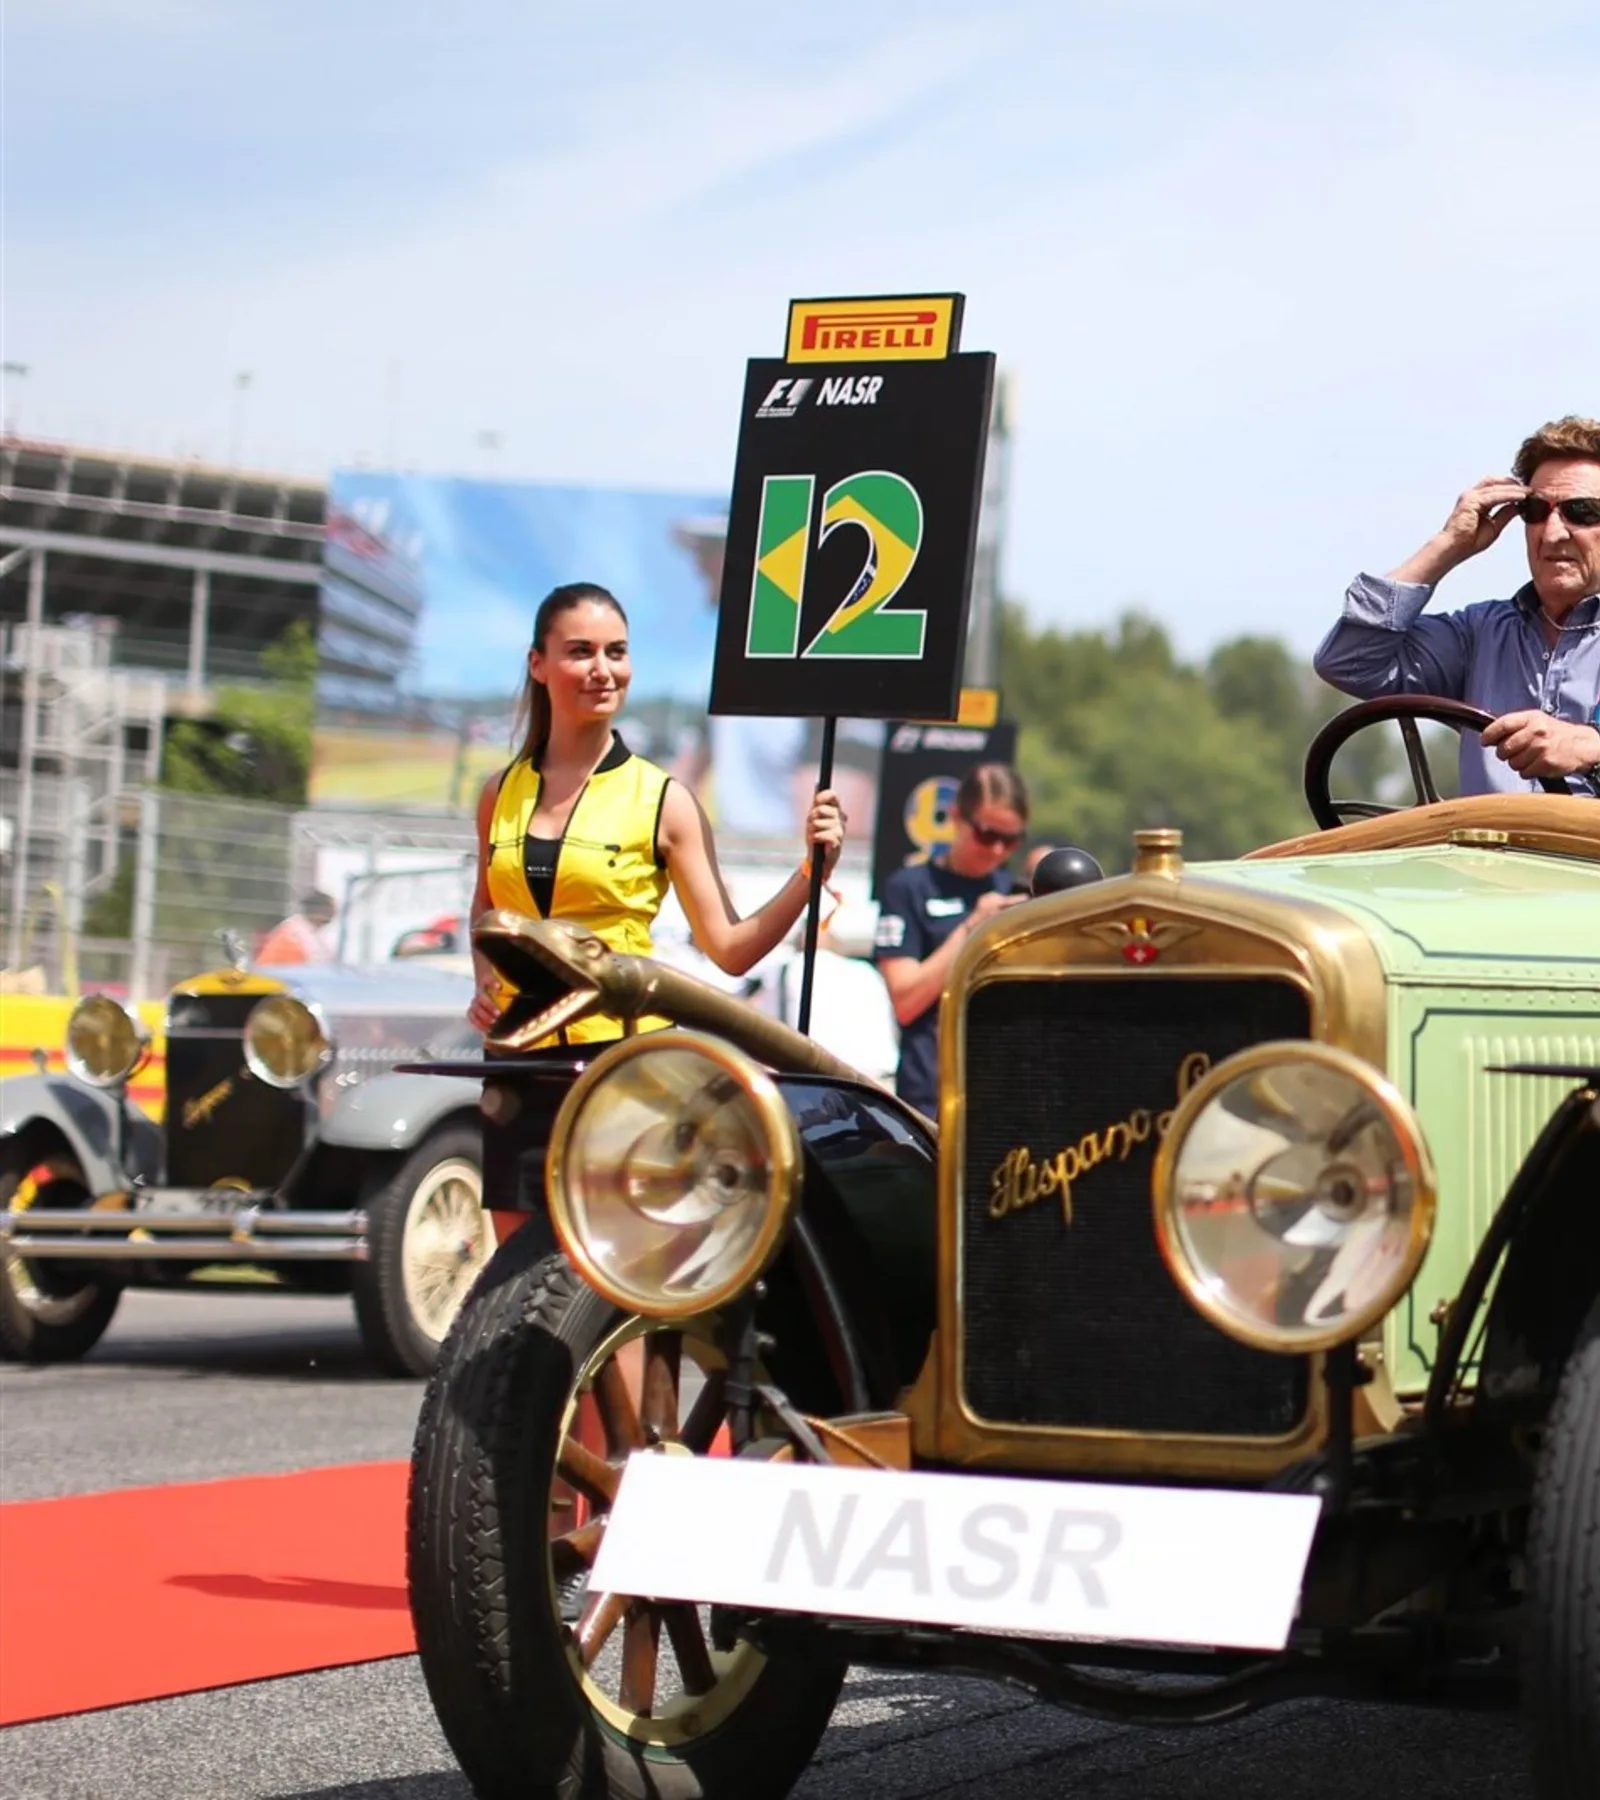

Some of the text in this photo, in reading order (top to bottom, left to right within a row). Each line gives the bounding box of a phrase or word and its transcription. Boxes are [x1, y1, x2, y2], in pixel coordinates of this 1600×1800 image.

[761, 375, 884, 407] F1 NASR
[801, 311, 937, 350] PIRELLI
[745, 470, 928, 660] 12
[989, 1107, 1152, 1229] Hispano
[762, 1489, 1124, 1610] NASR
